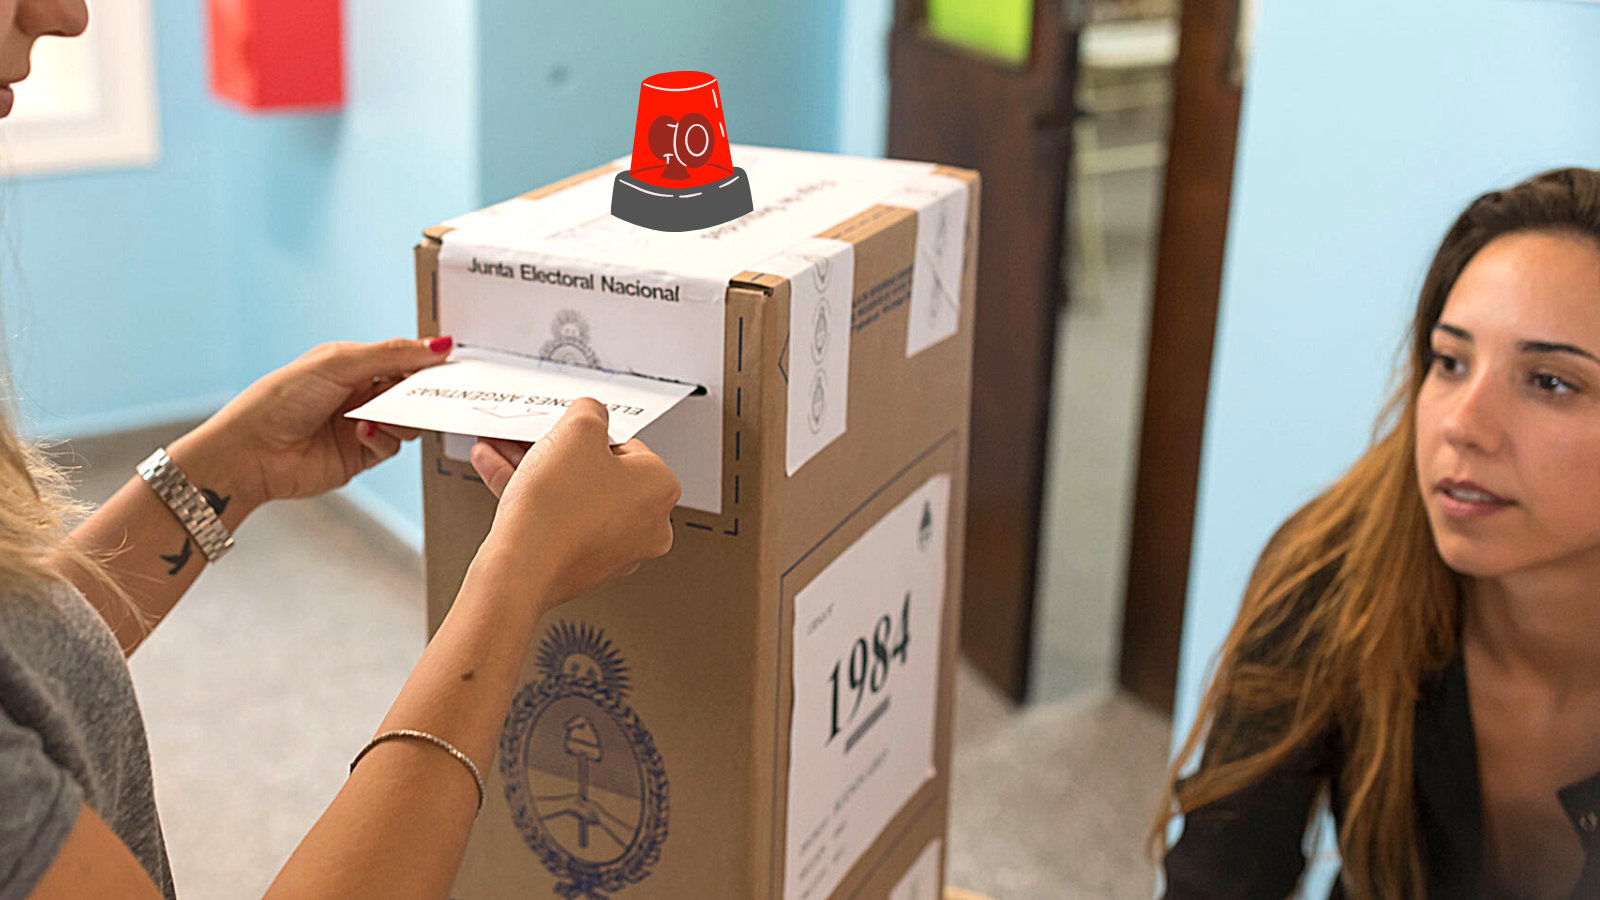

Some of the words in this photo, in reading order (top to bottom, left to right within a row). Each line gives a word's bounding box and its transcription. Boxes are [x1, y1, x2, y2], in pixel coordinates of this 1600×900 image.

[468, 257, 514, 278] Junta
[520, 264, 594, 290] Electoral
[601, 275, 680, 302] Nacional
[407, 387, 521, 402] ARGENTINAS
[524, 395, 645, 416] ELEONES
[826, 590, 911, 745] 1984
